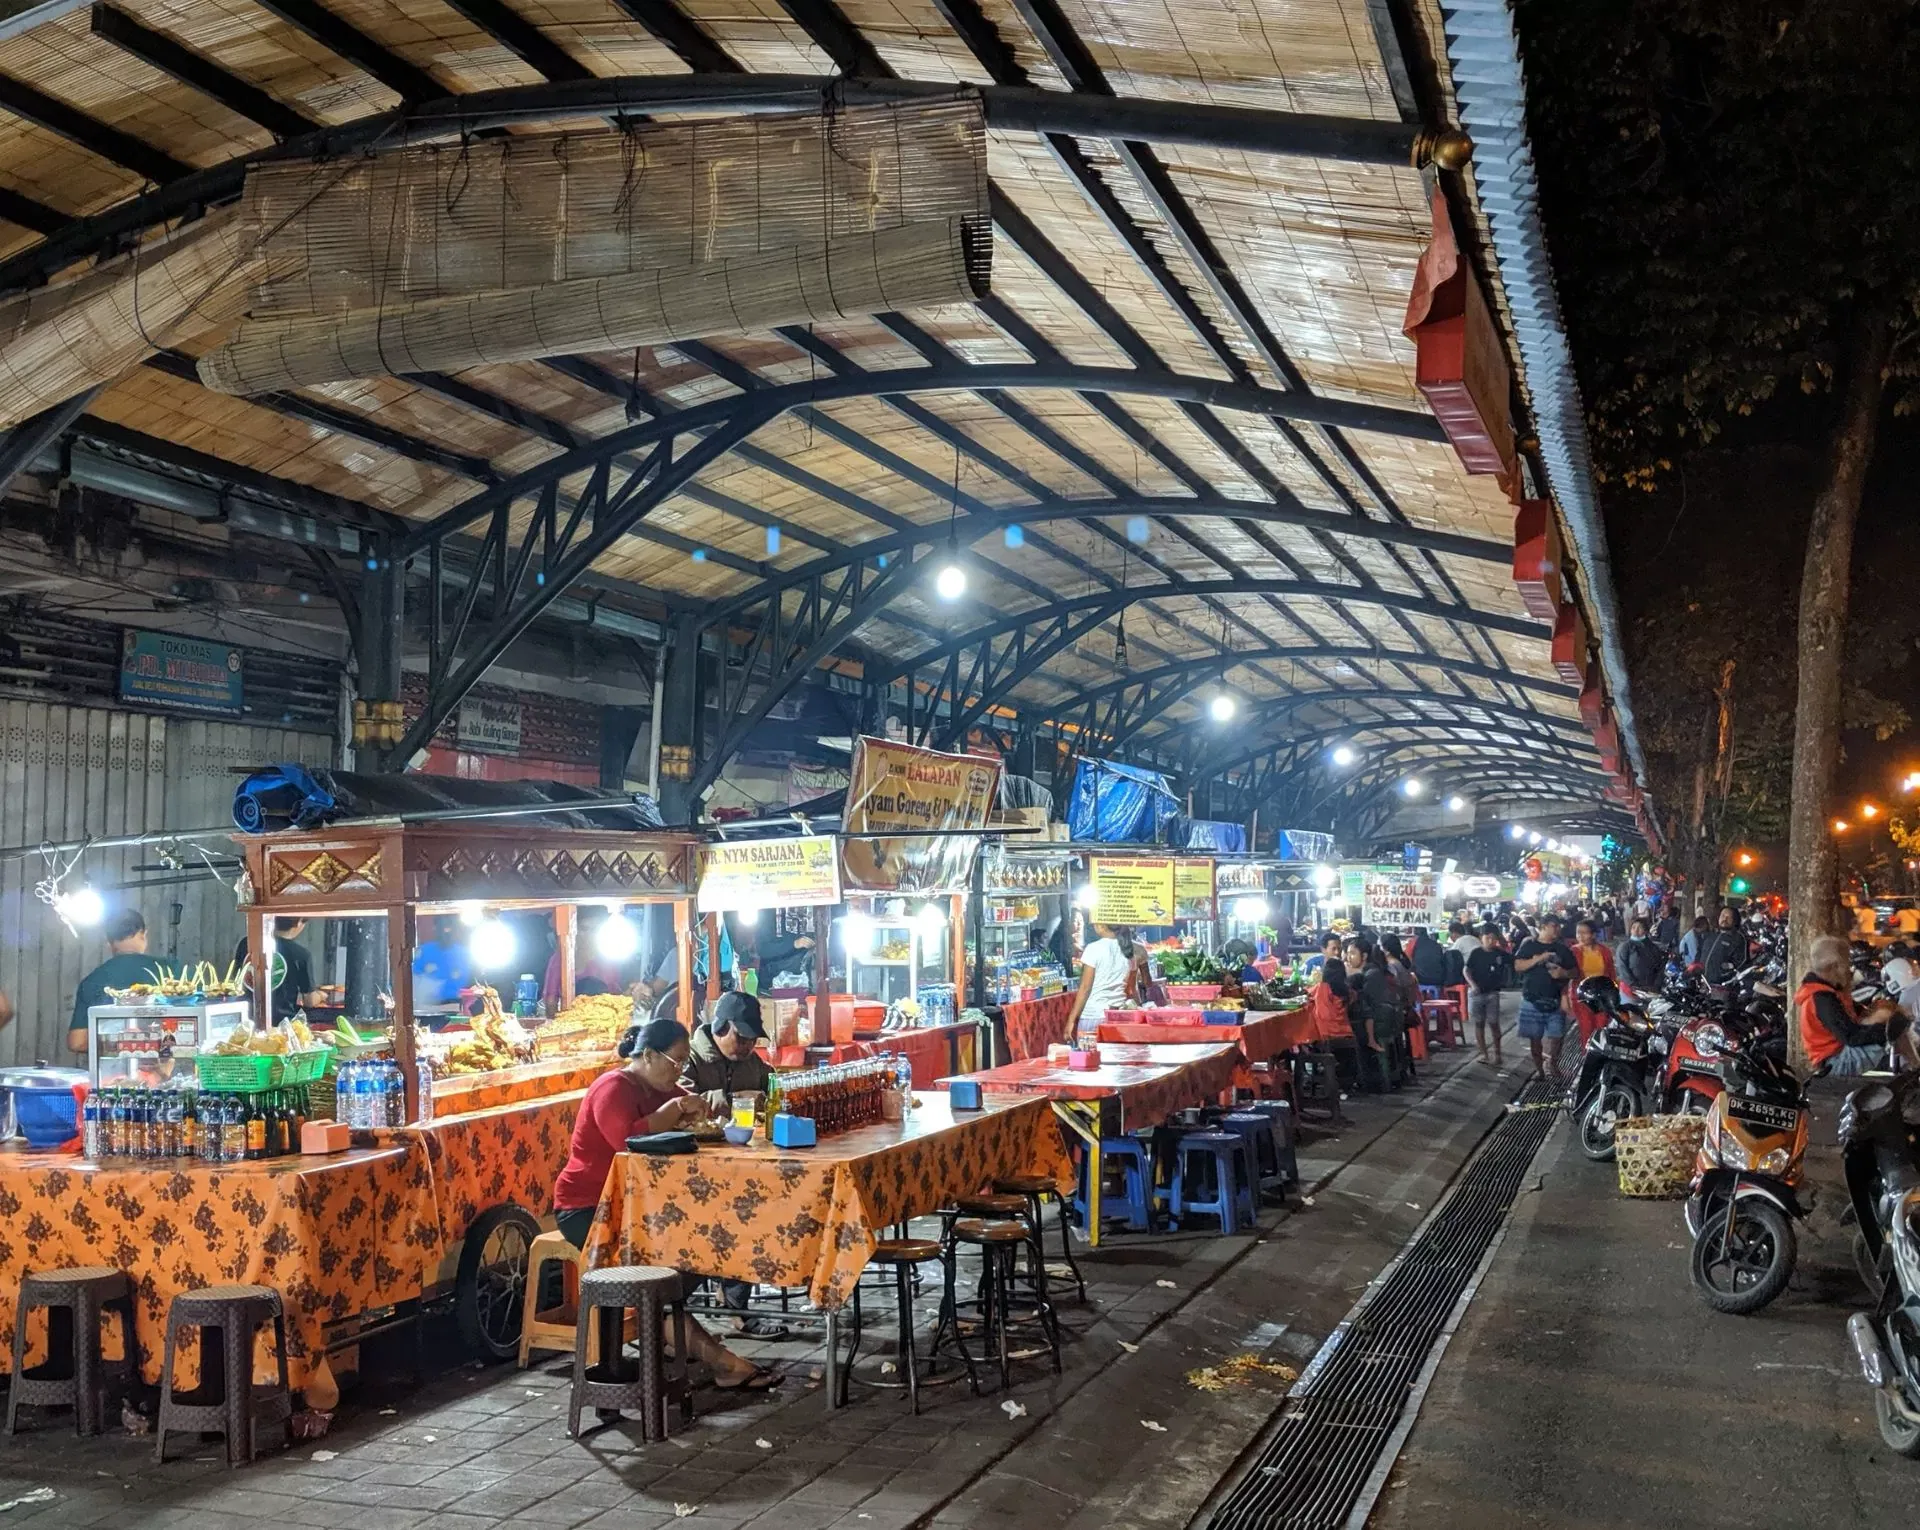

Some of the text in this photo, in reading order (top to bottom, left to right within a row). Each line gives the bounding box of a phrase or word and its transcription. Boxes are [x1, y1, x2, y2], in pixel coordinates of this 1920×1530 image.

[160, 640, 212, 659] TOKO MAS
[906, 762, 962, 787] LALAPAN
[896, 791, 932, 822] Goreng
[723, 848, 749, 863] NYM
[750, 843, 805, 862] SARJANA
[1365, 884, 1390, 896] SATE
[1372, 897, 1427, 909] KAMBING
[1371, 910, 1432, 924] SATE AYAM
[1730, 1099, 1795, 1120] DK 2655 KC
